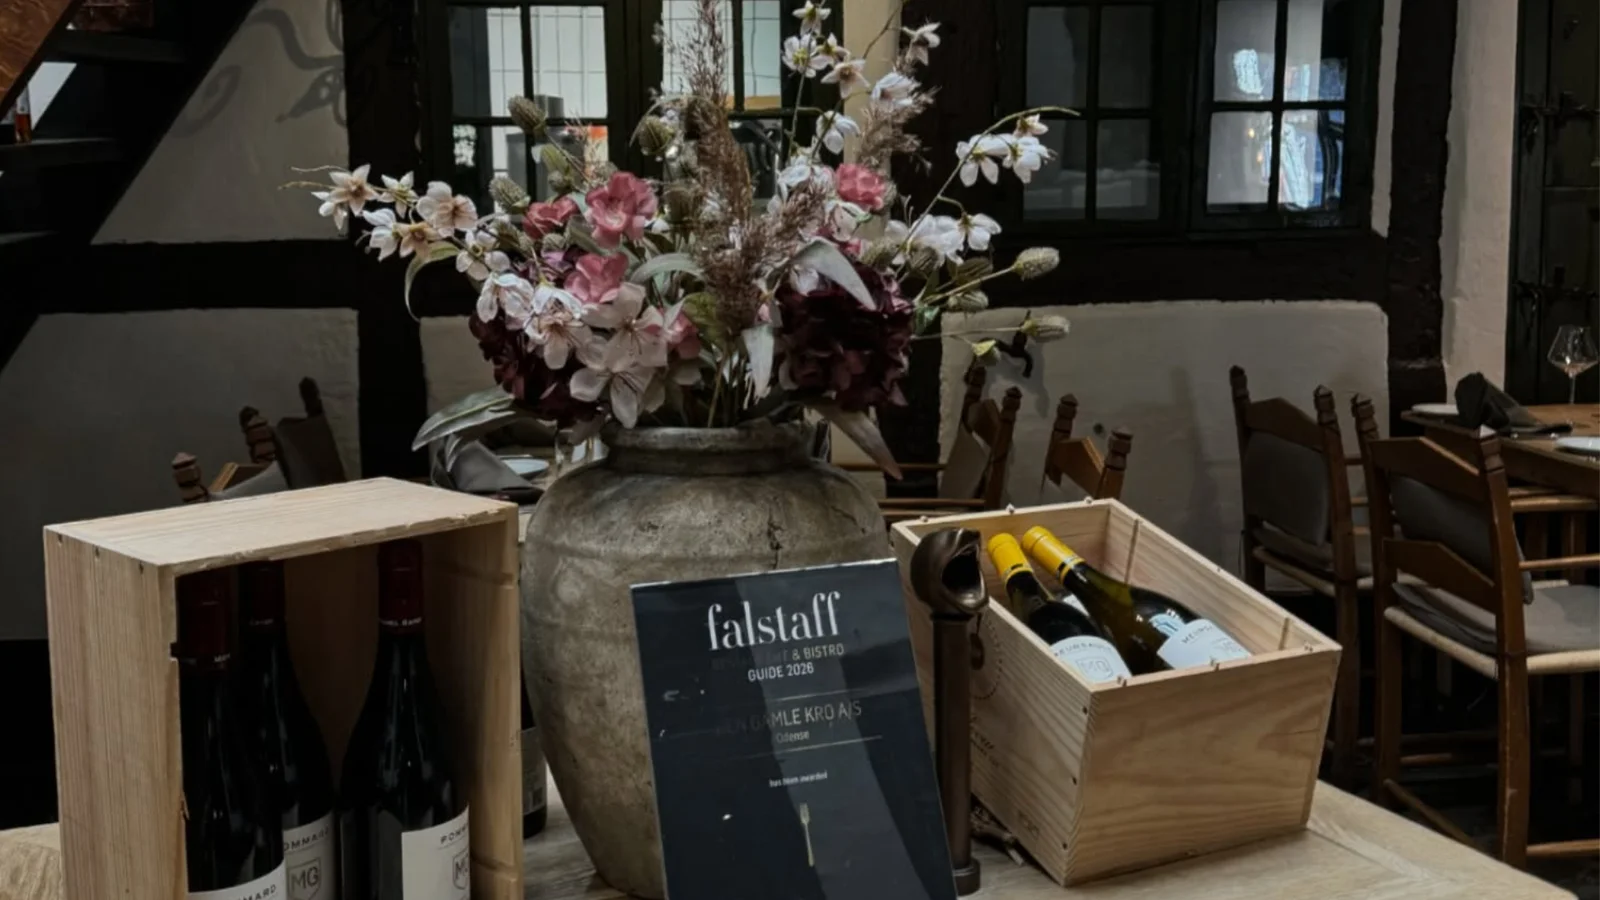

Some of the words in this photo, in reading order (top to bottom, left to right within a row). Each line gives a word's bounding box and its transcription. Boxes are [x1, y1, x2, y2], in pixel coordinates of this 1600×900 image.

[707, 591, 840, 650] falstaff
[791, 648, 801, 661] &
[803, 643, 845, 660] BISTRO
[747, 664, 784, 682] GUIDE
[804, 703, 835, 723] KRO
[775, 729, 810, 744] Odense
[283, 826, 329, 851] OMMARD
[291, 866, 320, 891] MG
